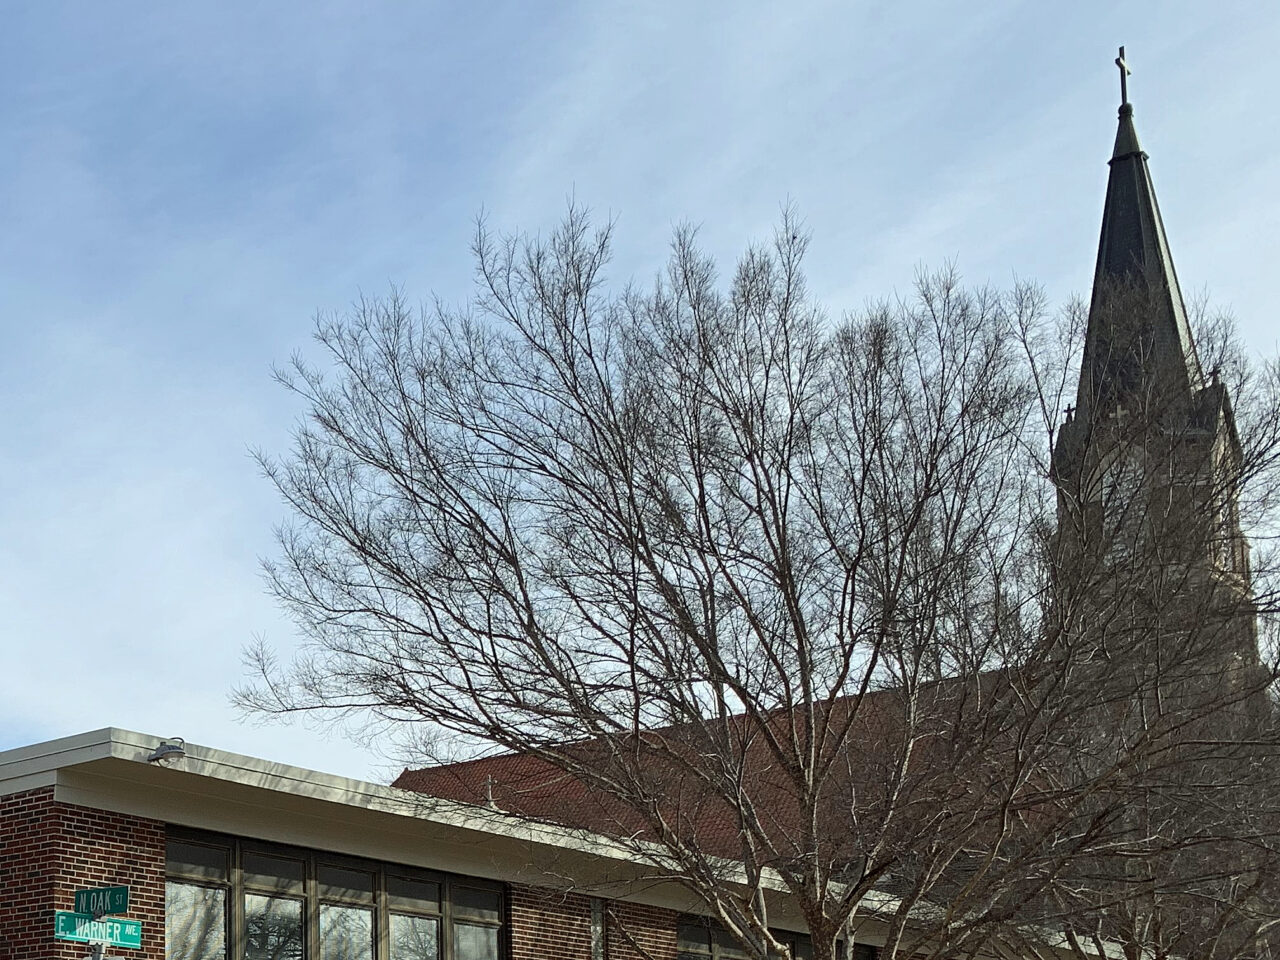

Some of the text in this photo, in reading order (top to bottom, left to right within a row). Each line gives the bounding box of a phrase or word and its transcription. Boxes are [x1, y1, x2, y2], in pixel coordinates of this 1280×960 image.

[90, 890, 111, 912] OAK
[115, 894, 124, 906] ST
[75, 917, 121, 942] WARNER
